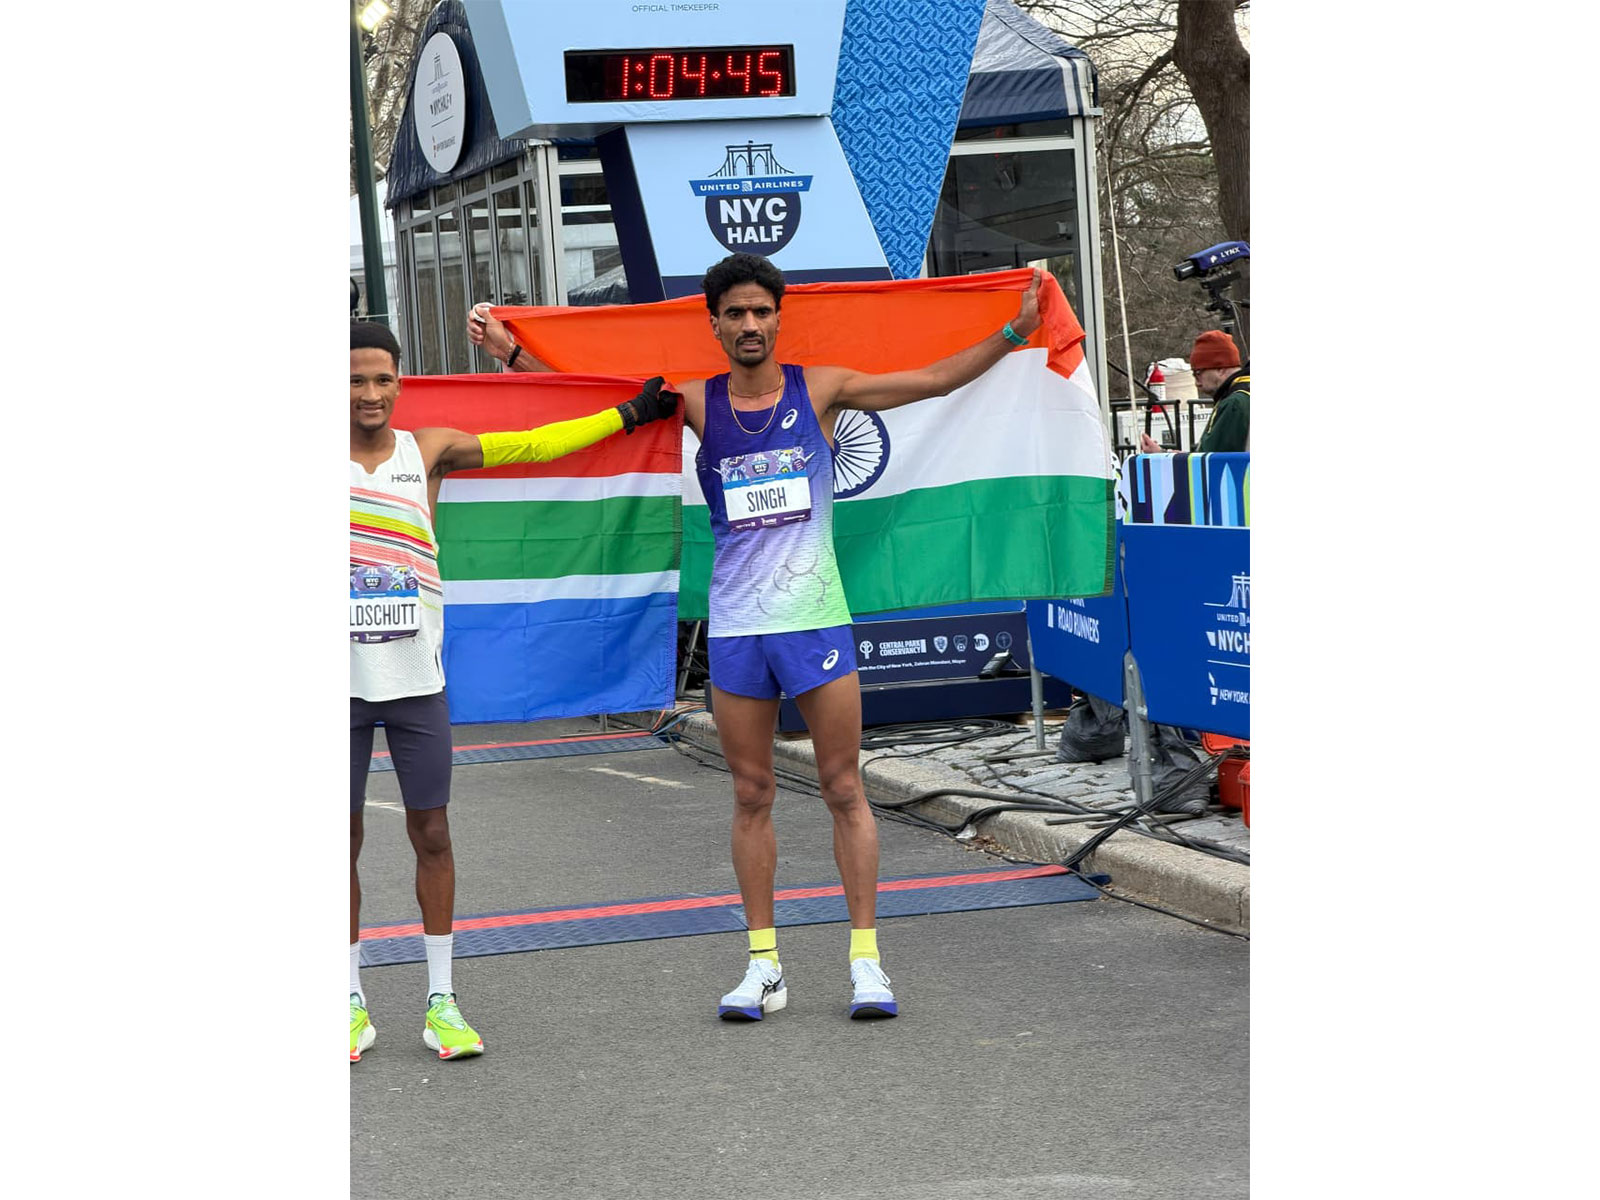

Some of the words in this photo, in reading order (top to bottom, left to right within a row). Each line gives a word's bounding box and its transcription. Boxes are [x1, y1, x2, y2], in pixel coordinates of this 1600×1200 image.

[671, 3, 719, 11] TIMEKEEPER
[754, 180, 804, 189] AIRLINES
[719, 197, 787, 224] NYC
[727, 225, 784, 244] HALF
[1220, 246, 1241, 258] LYNX
[391, 473, 421, 483] HOKA
[746, 486, 787, 513] SINGH
[350, 603, 416, 626] LDSCHUTT
[1216, 613, 1239, 623] UNITED
[1057, 606, 1073, 634] ROAD
[1073, 611, 1100, 644] RUNNERS
[879, 640, 906, 650] CENTRAL
[906, 639, 921, 648] PARK
[879, 647, 921, 657] CONSERVANCY
[1219, 688, 1232, 701] NEW
[1231, 690, 1249, 704] YORK
